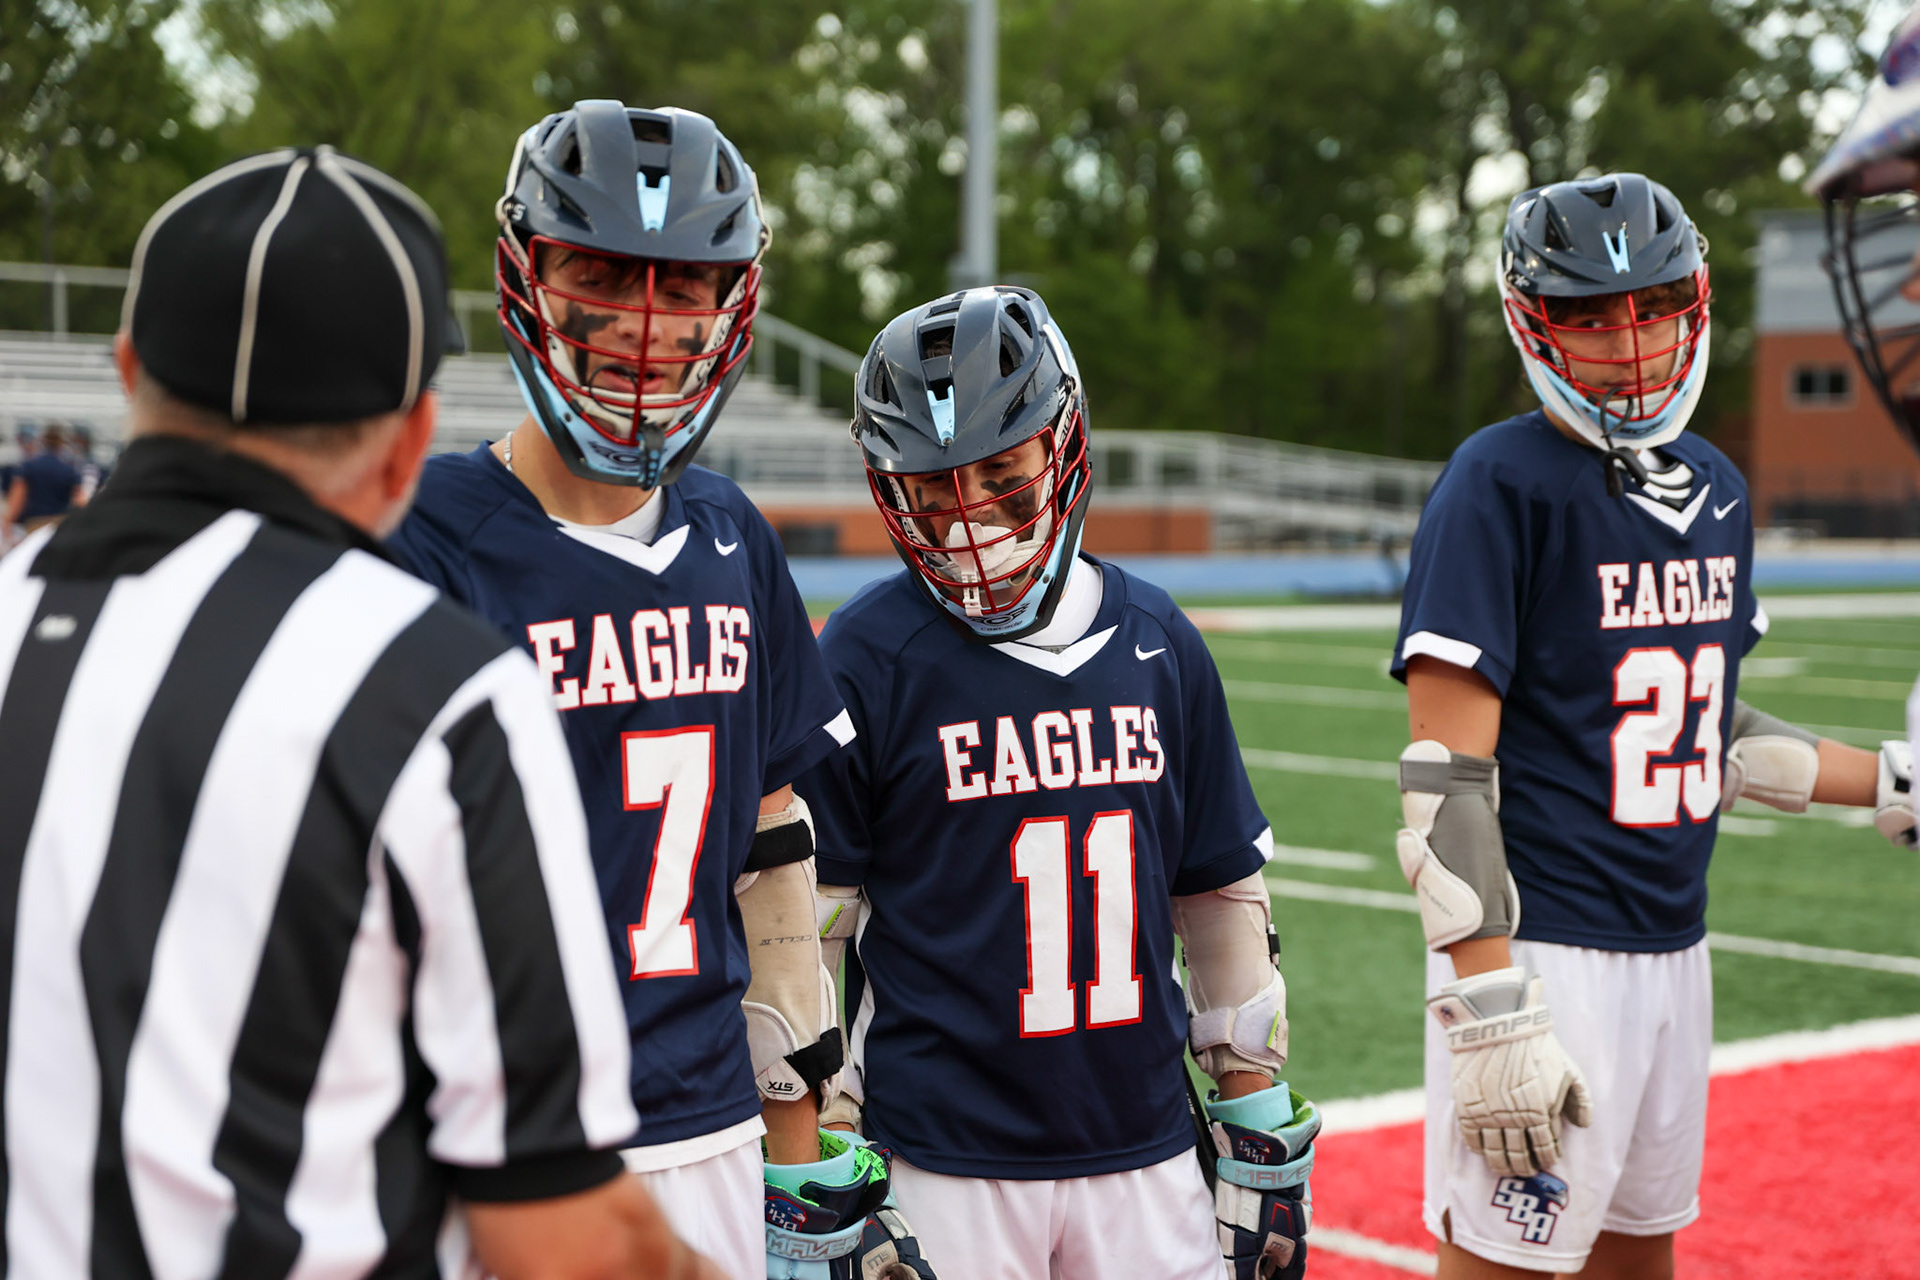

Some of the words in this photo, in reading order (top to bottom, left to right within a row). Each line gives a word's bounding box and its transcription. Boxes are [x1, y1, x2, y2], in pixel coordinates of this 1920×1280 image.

[1597, 556, 1736, 629] EAGLES
[526, 605, 751, 711] EAGLES
[937, 705, 1165, 802] EAGLES
[1608, 642, 1726, 829] 23
[620, 724, 715, 981] 7
[1010, 809, 1143, 1039] 11
[767, 1080, 794, 1092] STX
[1492, 1176, 1557, 1244] SBA
